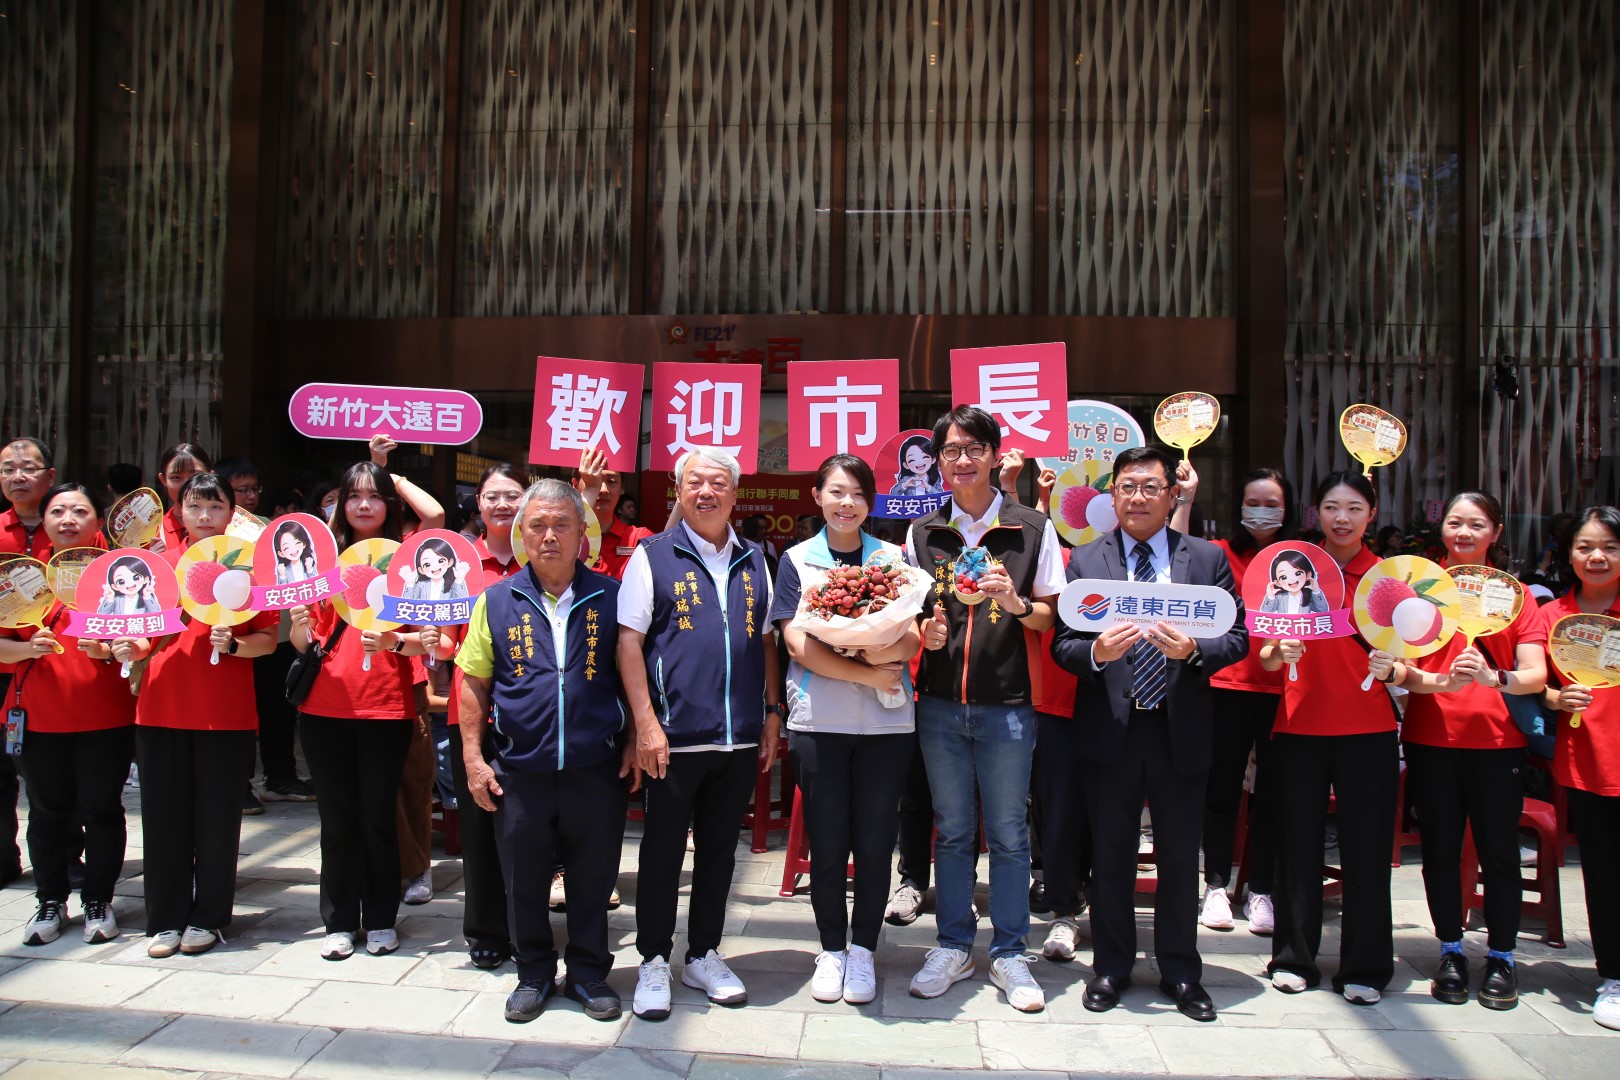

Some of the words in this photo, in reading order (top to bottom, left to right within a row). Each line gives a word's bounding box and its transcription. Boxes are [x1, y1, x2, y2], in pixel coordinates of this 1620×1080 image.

[306, 395, 465, 432] 新竹大遠百
[546, 373, 628, 455] 歡
[666, 379, 743, 456] 迎
[803, 376, 883, 455] 市
[970, 361, 1051, 442] 長
[1068, 422, 1128, 443] 竹夏日
[265, 576, 331, 607] 安安市長
[395, 600, 470, 622] 安安駕到
[673, 581, 694, 631] 郭瑞誠
[685, 571, 703, 605] 理事長
[742, 570, 755, 639] 新竹市農會
[1114, 595, 1217, 620] 遠東百貨
[84, 614, 166, 635] 安安駕到
[521, 612, 535, 659] 常務監事
[584, 607, 599, 681] 新竹市農會
[1253, 615, 1334, 636] 安安市長
[507, 625, 525, 677] 劉進士
